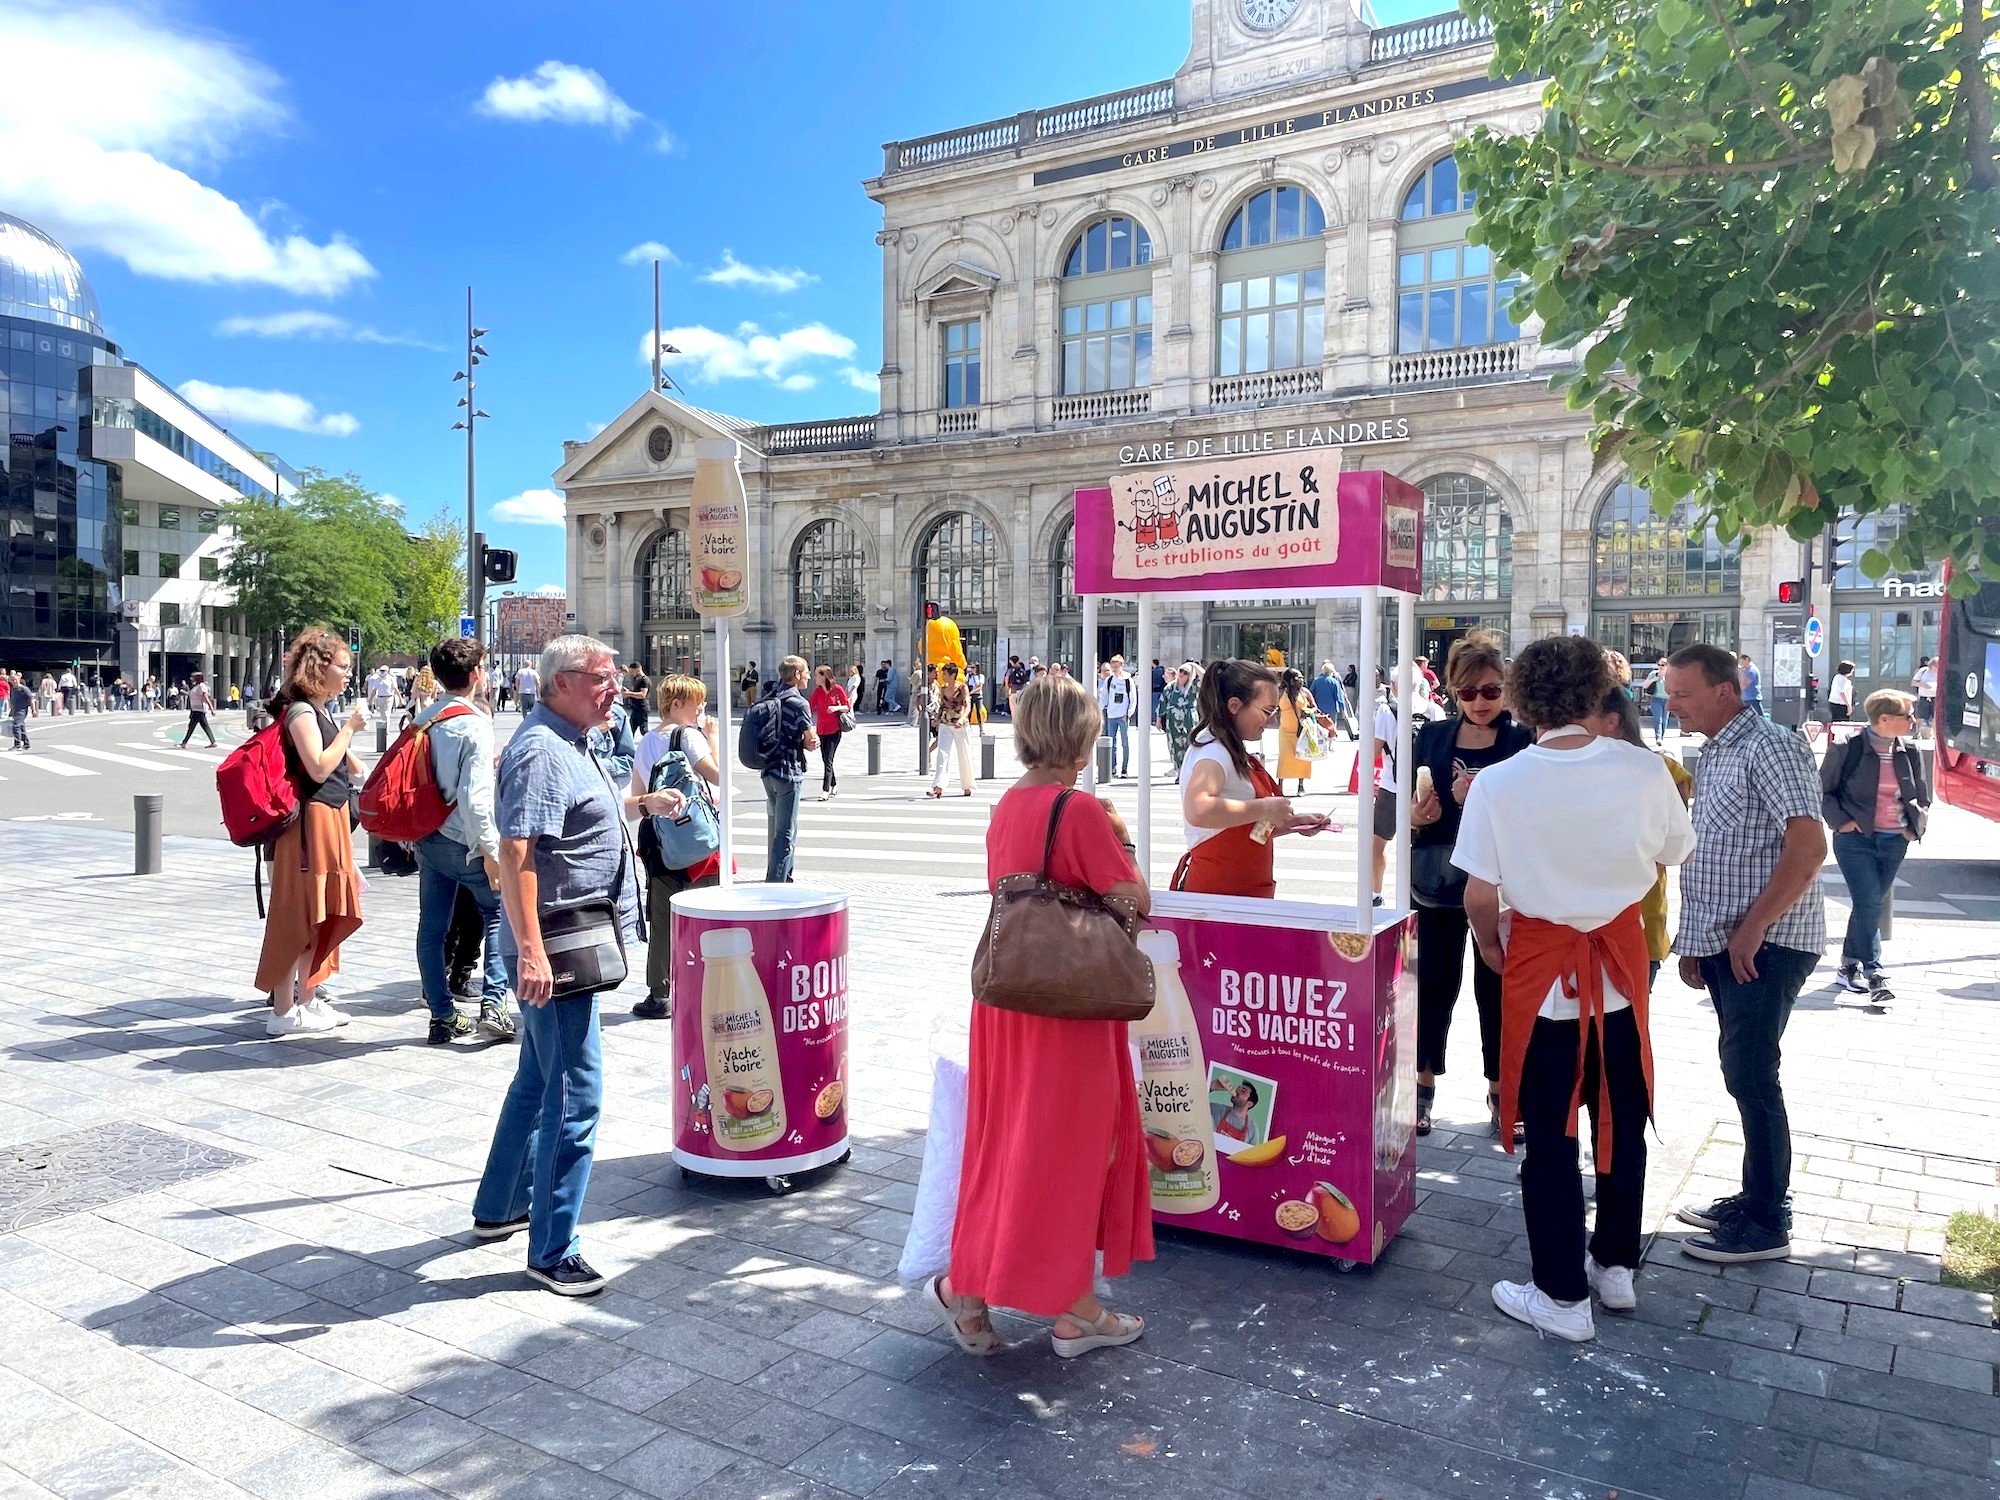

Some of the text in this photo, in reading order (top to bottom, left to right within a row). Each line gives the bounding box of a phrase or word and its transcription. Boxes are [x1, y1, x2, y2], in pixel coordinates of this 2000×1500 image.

[1122, 88, 1436, 167] GARE DE LILLE FLANDRES
[1119, 417, 1409, 464] GARE DE LILLE FLANDRES
[1299, 465, 1320, 494] &
[704, 533, 735, 545] Vache
[704, 544, 736, 555] à boire
[1135, 537, 1321, 568] Les trublions du goût
[1882, 577, 1946, 598] fnac
[1220, 969, 1348, 1020] BOIVEZ
[783, 1002, 820, 1033] DES
[1212, 1007, 1252, 1038] DES
[1258, 1012, 1341, 1050] VACHES
[1348, 1023, 1355, 1051] !
[1181, 1036, 1188, 1046] &
[722, 1046, 760, 1062] Vache
[1246, 1048, 1270, 1056] excuses
[1271, 1046, 1276, 1054] à
[1278, 1046, 1291, 1056] tous
[1292, 1048, 1301, 1058] les
[1302, 1053, 1321, 1065] profs
[1321, 1060, 1331, 1068] de
[1333, 1061, 1360, 1075] français
[723, 1059, 763, 1074] à boire
[1143, 1079, 1188, 1098] Vache
[1144, 1096, 1192, 1113] à boire
[1302, 1140, 1337, 1155] Alphonso
[1306, 1131, 1337, 1146] Mangue
[1307, 1152, 1331, 1166] d'Inde
